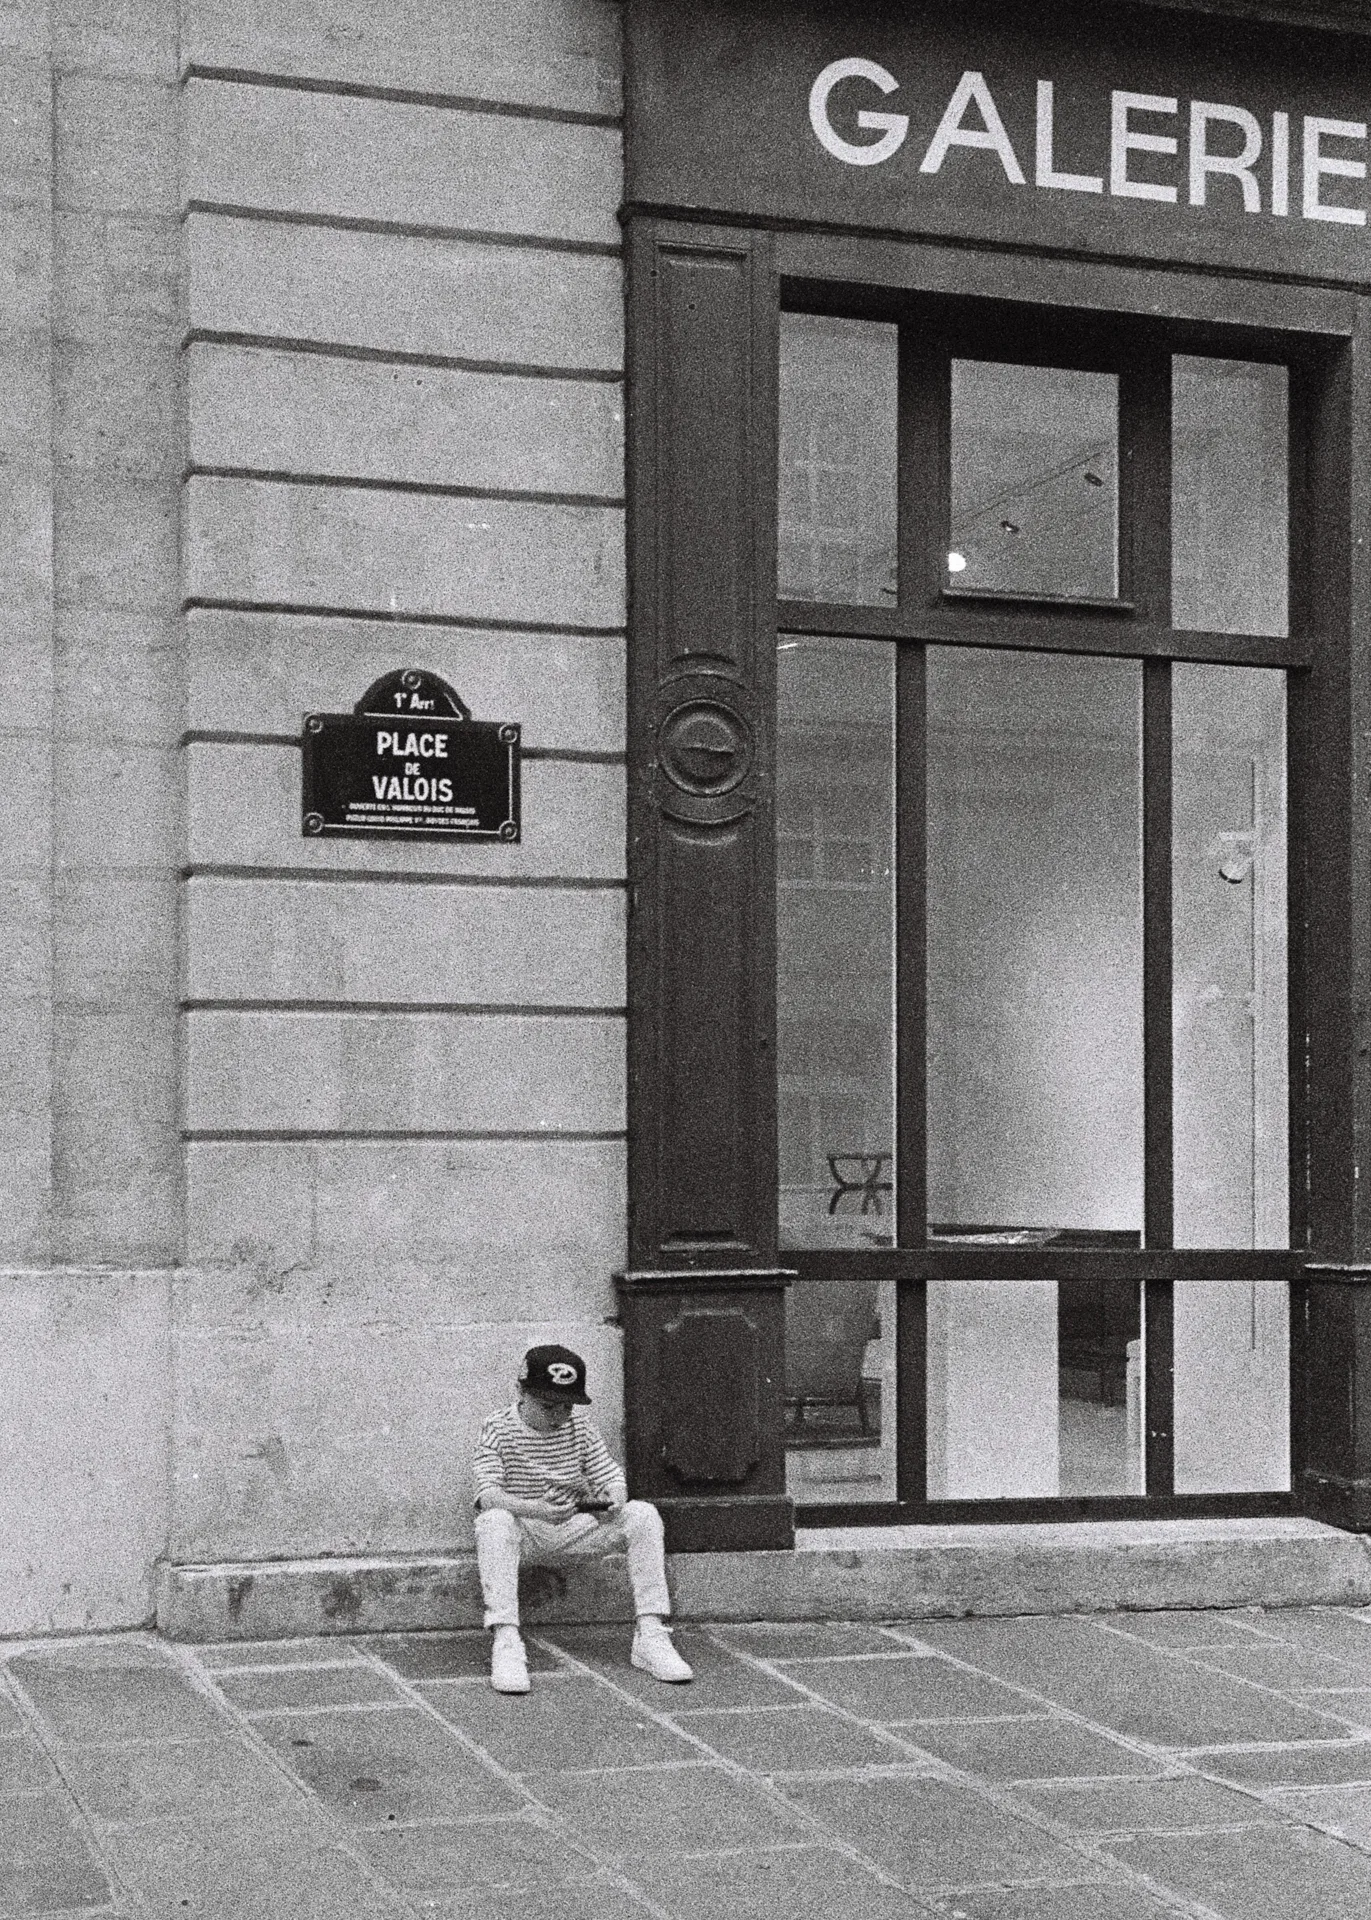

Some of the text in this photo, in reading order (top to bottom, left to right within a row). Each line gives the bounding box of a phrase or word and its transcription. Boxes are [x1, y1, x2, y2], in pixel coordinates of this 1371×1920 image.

[808, 56, 1367, 226] GALERIE
[376, 731, 449, 758] PLACE
[404, 762, 421, 776] DE
[372, 775, 453, 802] VALOIS
